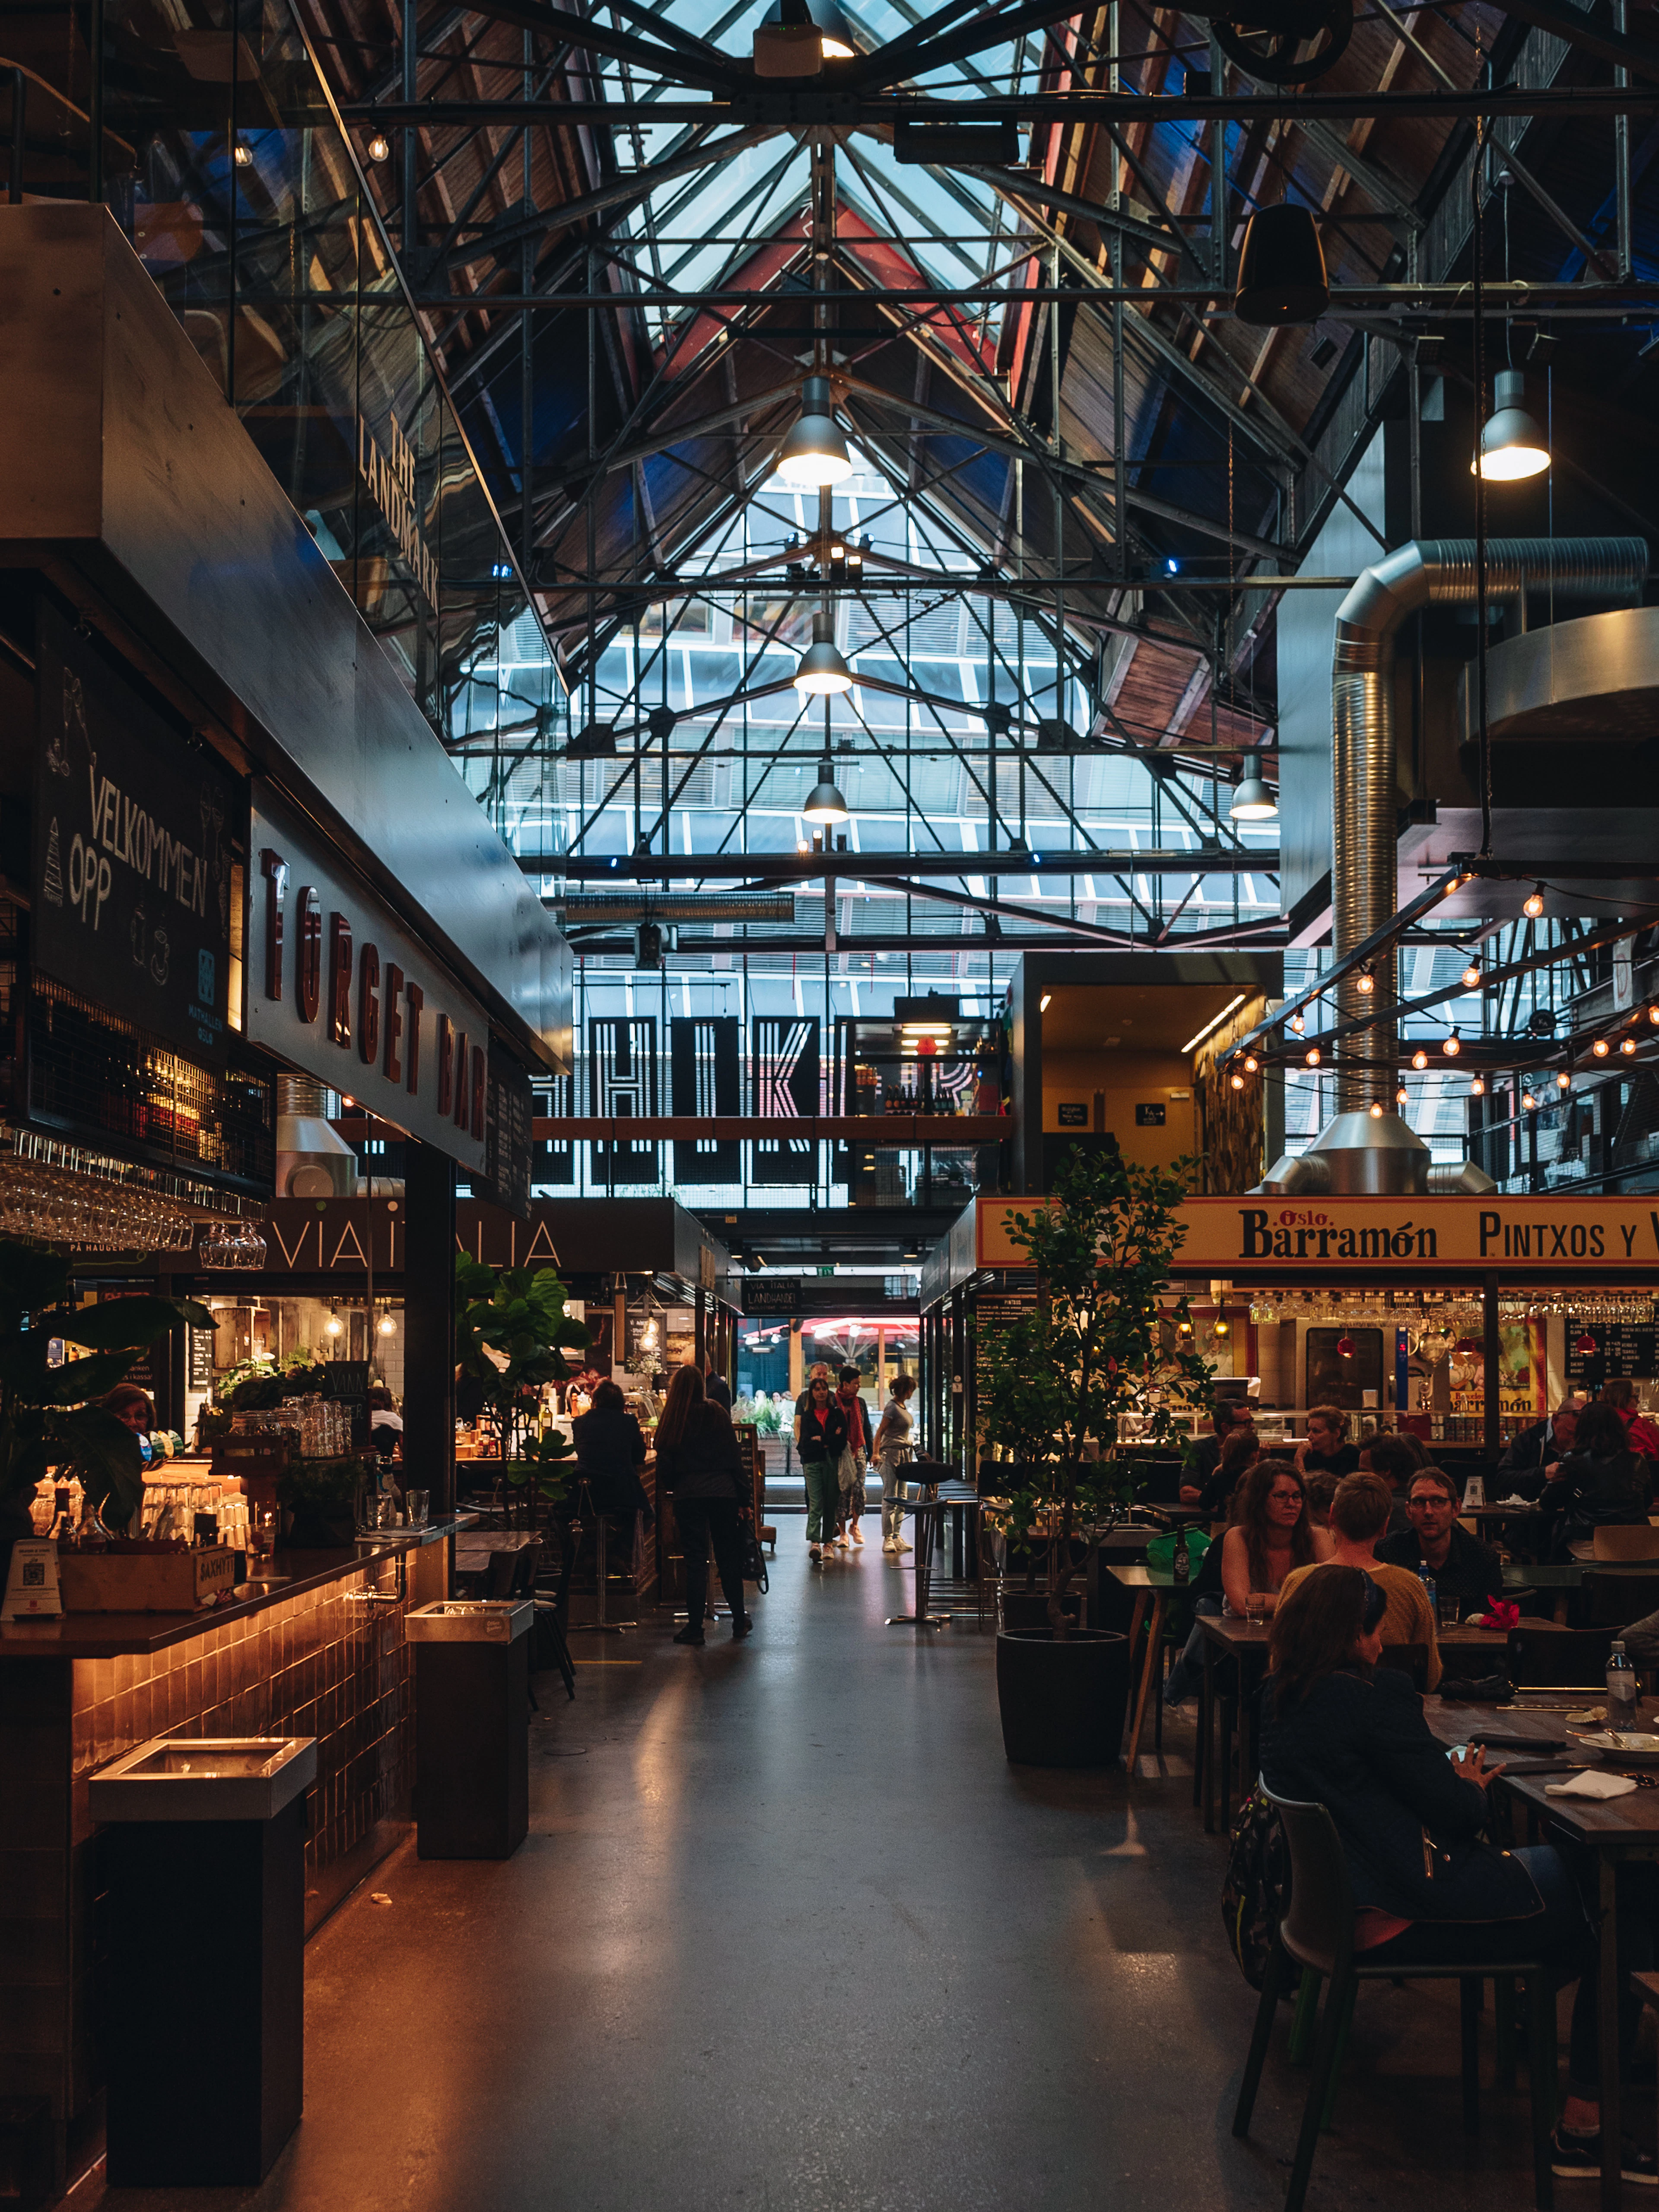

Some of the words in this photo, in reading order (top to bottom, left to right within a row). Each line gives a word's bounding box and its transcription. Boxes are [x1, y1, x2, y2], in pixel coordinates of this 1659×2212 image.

[390, 411, 416, 510] THE
[359, 413, 439, 617] LANDMARK
[68, 834, 111, 931] OPP
[90, 765, 208, 918] VELKOMMEN
[261, 848, 424, 1095] TORGET
[437, 1013, 485, 1142] BAR
[272, 1220, 368, 1268] VIA
[1239, 1209, 1438, 1258] Barramón
[1620, 1225, 1637, 1257] Y
[748, 1292, 797, 1304] LANDHANDEL
[750, 1282, 765, 1290] VIA
